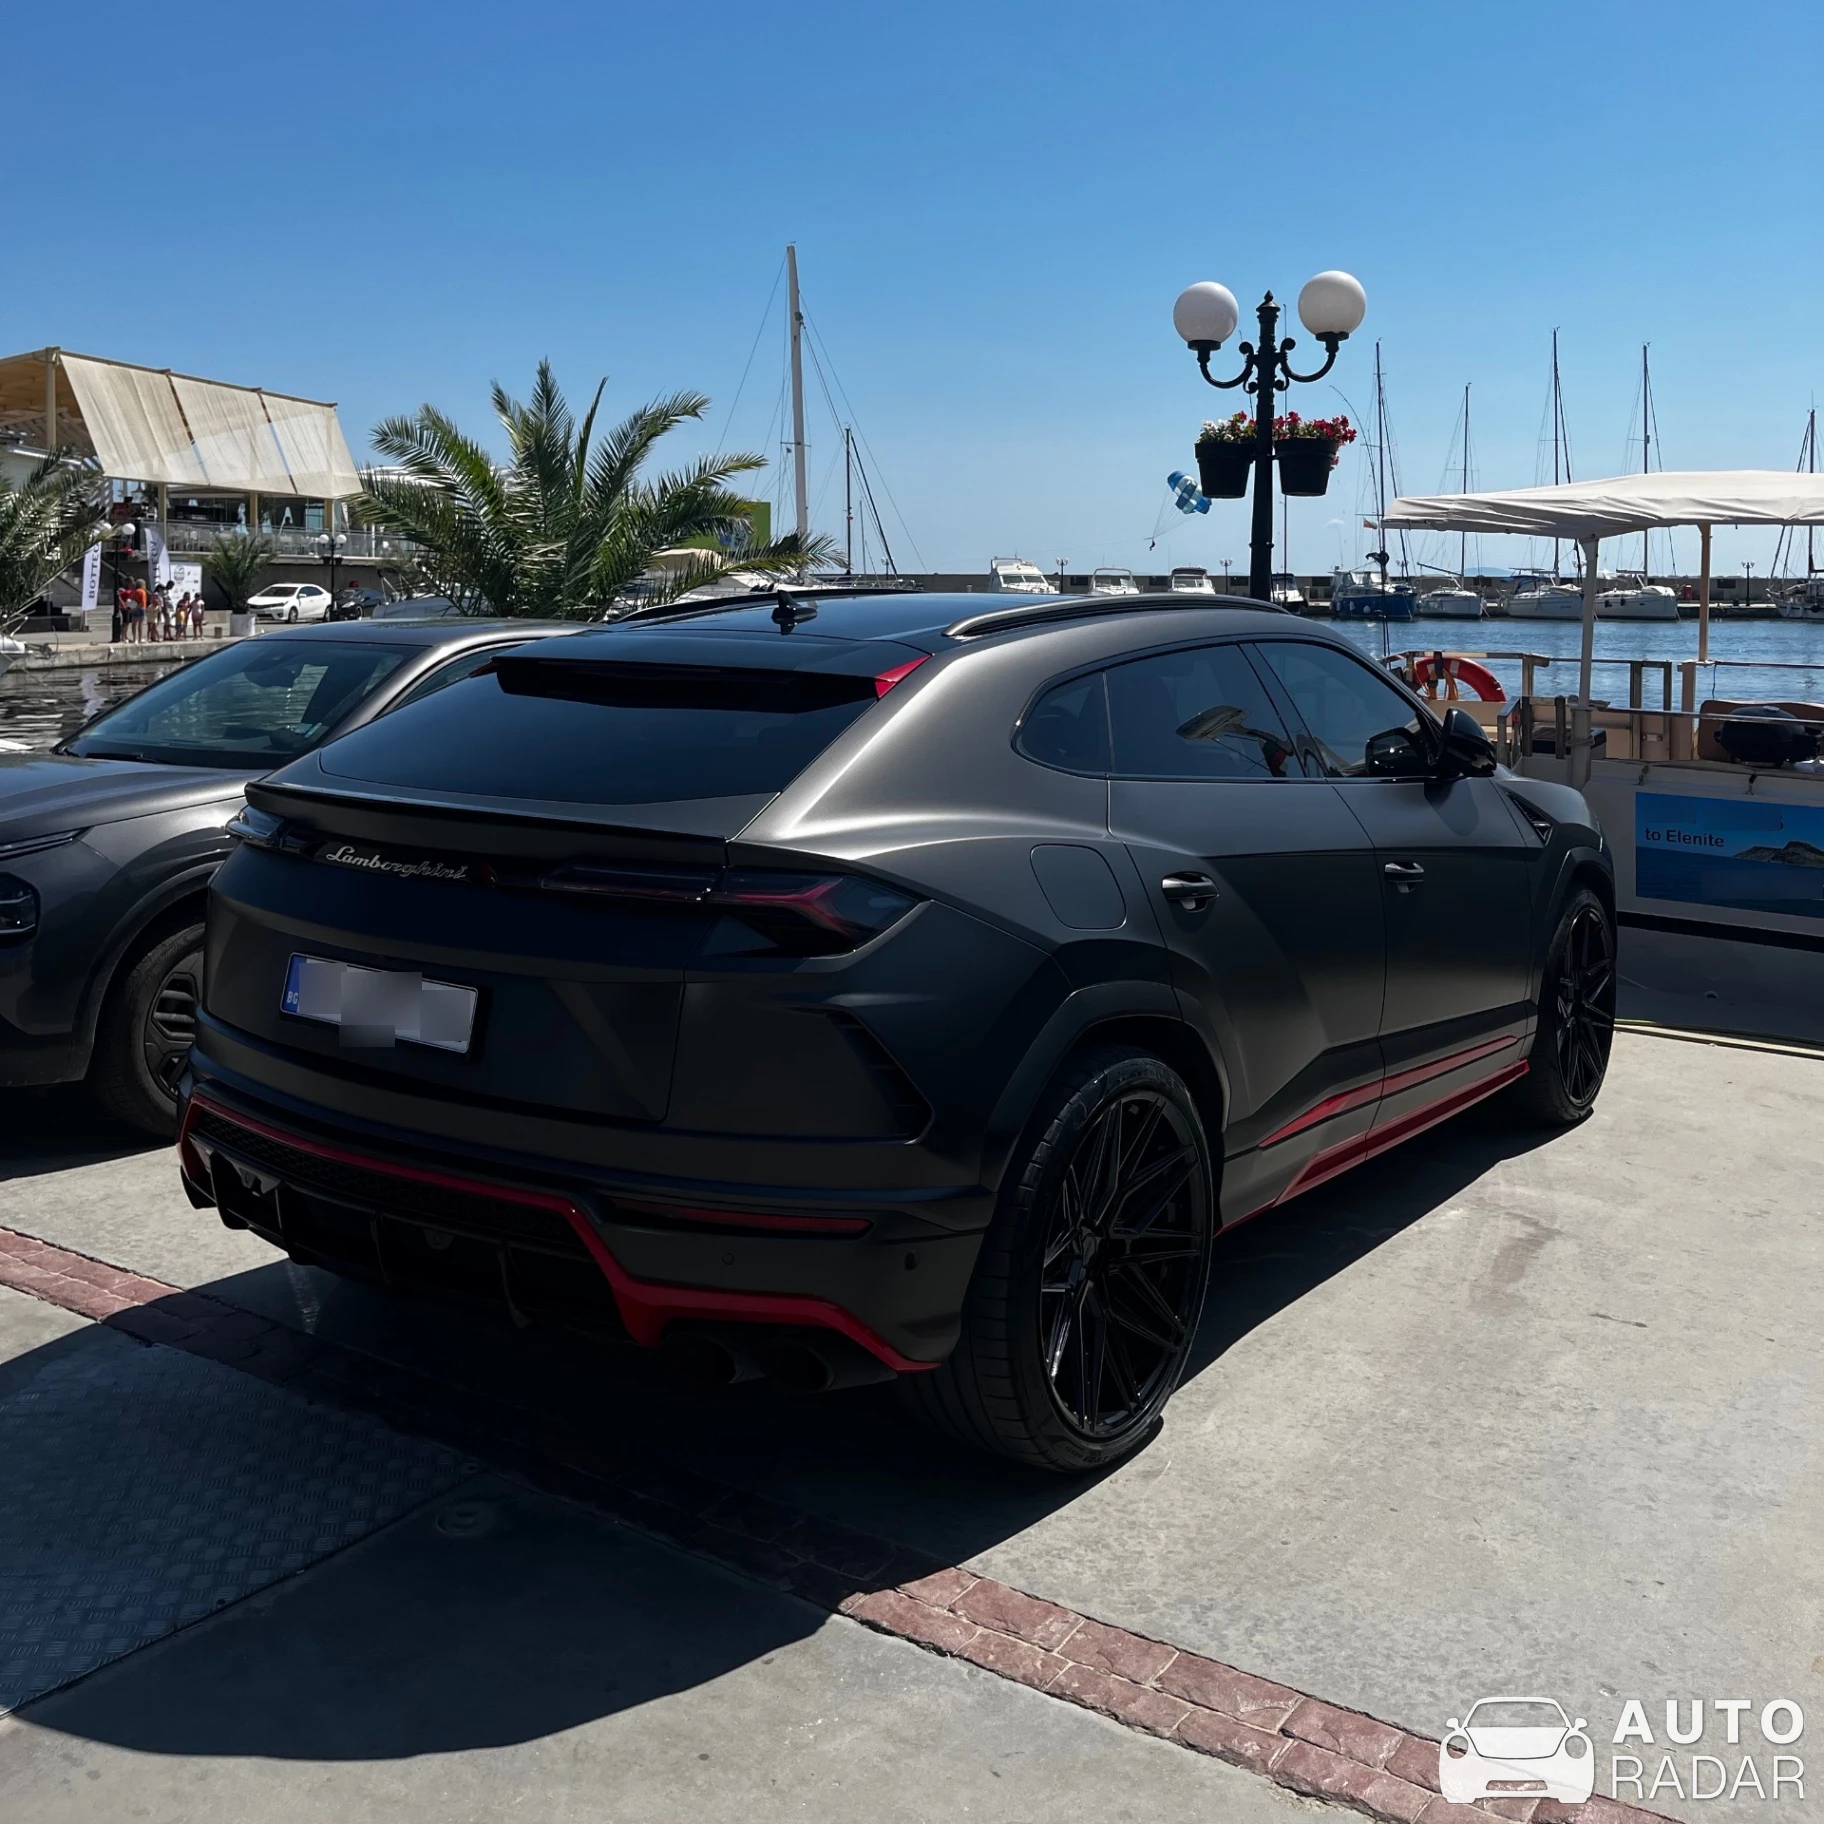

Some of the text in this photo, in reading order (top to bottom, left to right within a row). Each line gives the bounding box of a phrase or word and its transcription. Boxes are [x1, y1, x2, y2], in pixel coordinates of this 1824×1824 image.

[1645, 828, 1725, 848] to Elenite
[325, 846, 469, 879] Lamborghini
[286, 990, 299, 1005] BG
